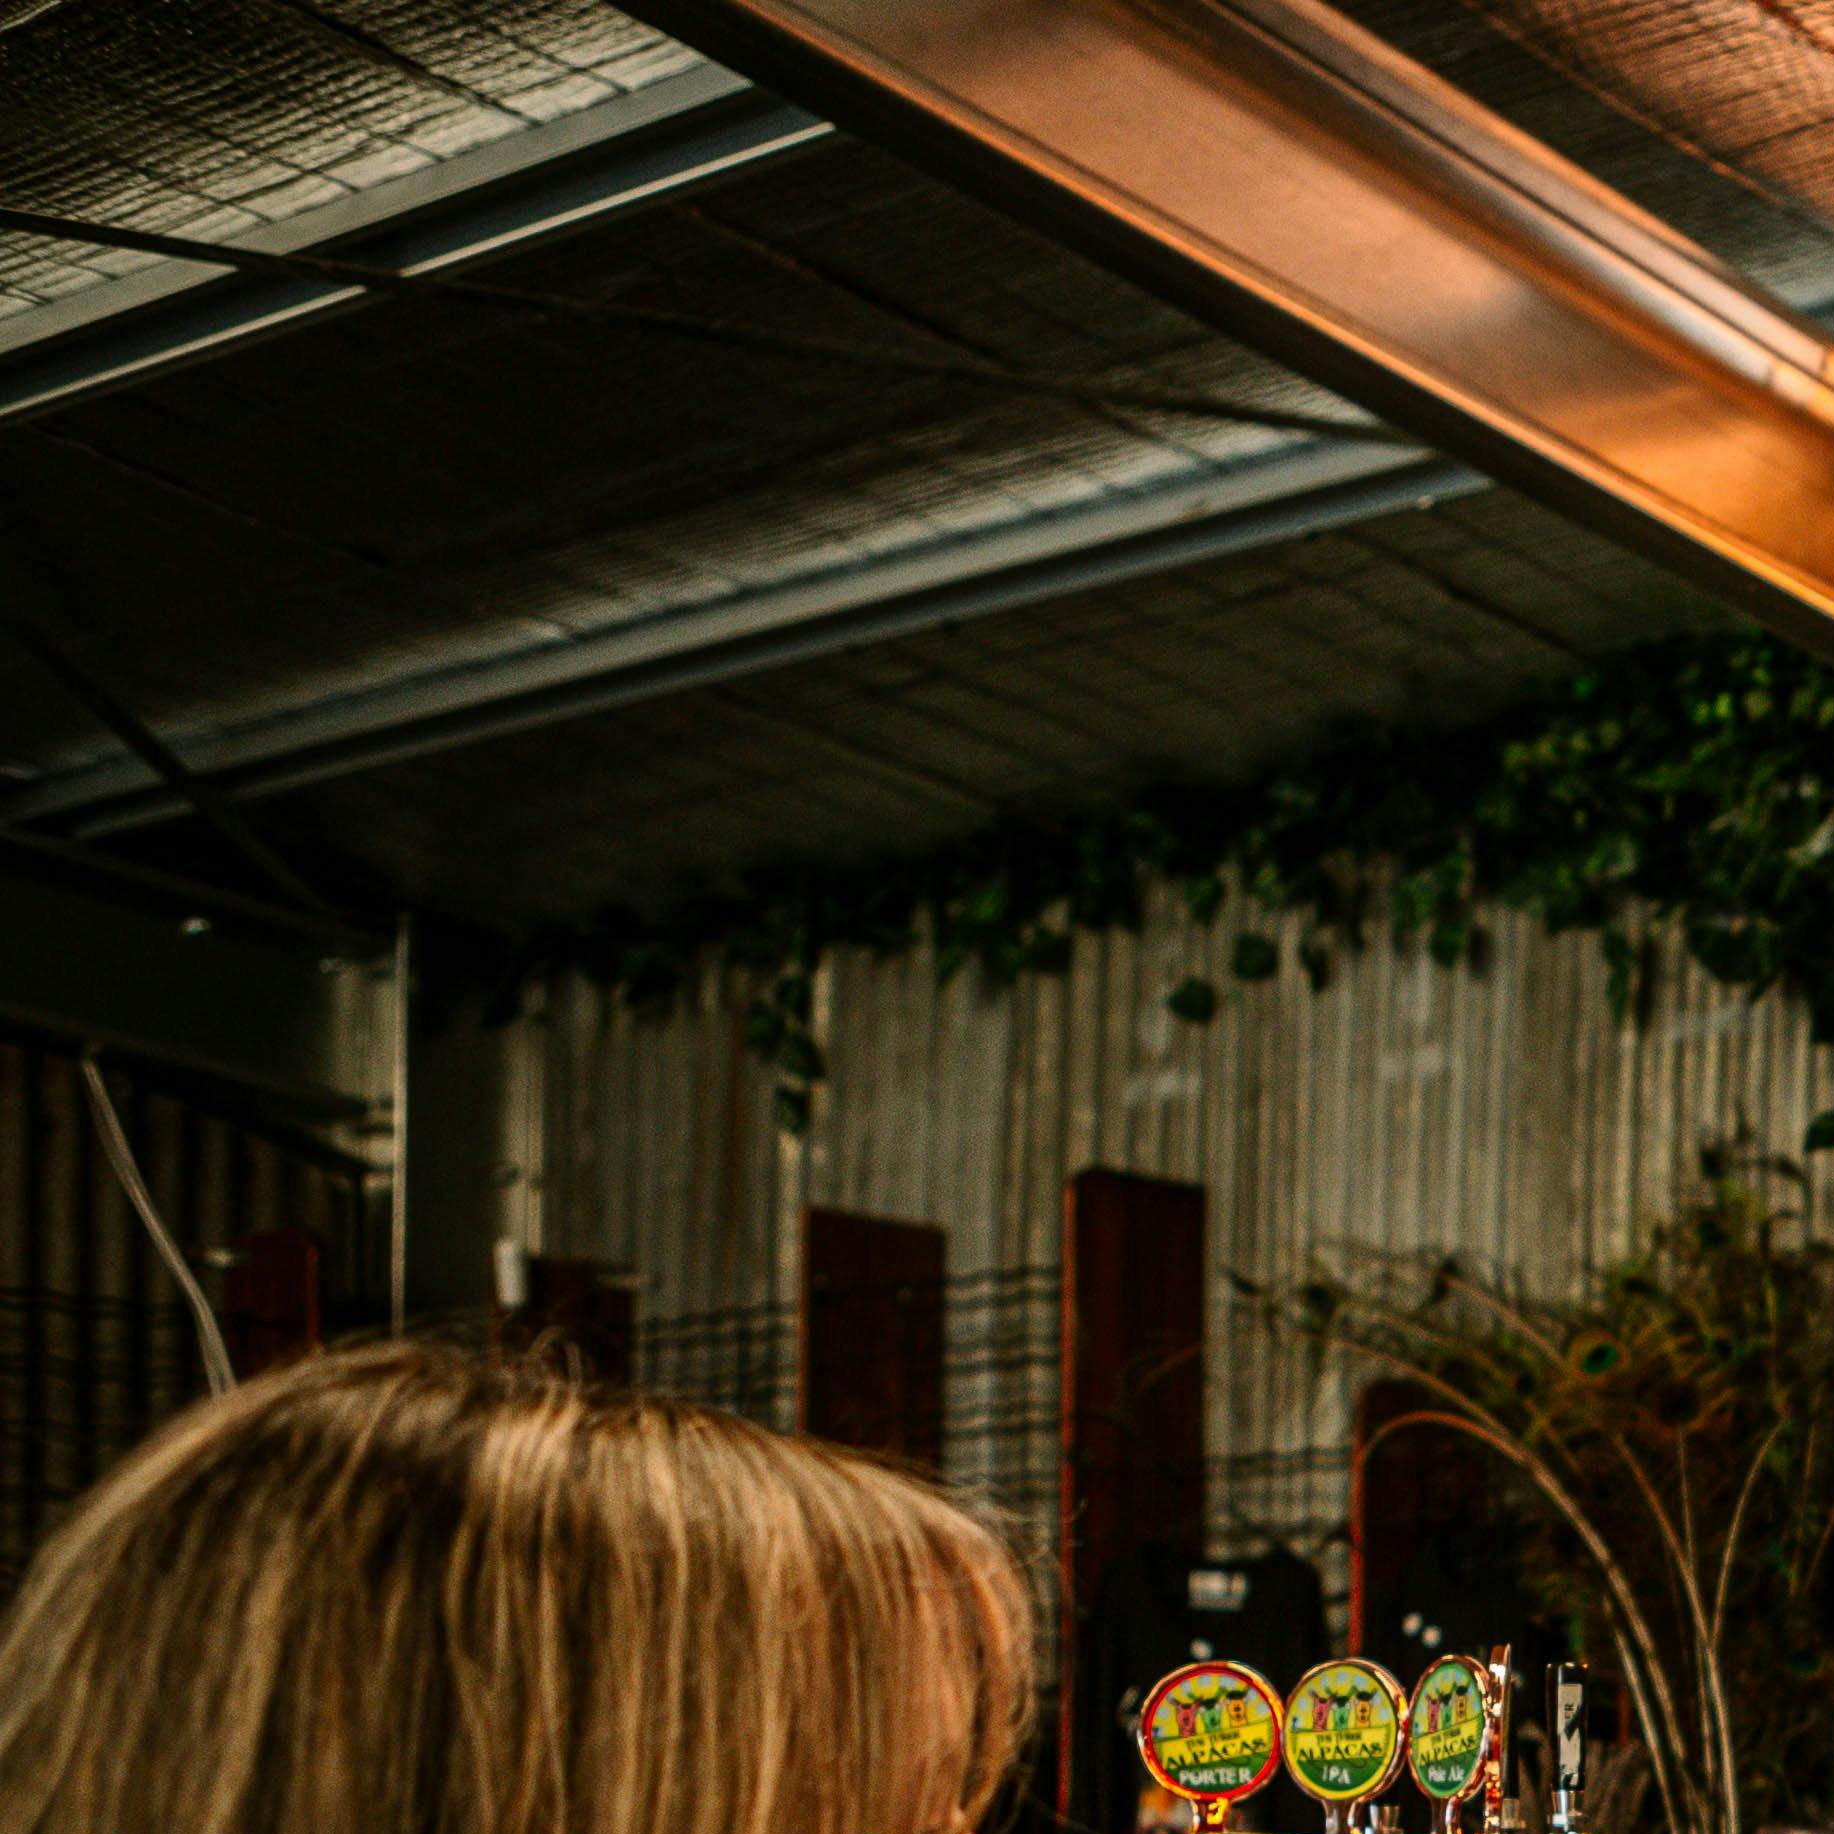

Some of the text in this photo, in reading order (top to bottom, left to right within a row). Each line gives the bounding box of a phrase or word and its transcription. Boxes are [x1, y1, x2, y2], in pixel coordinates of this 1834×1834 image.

[1166, 1737, 1267, 1769] ALPACAS
[1298, 1742, 1383, 1764] ALPACAS
[1179, 1767, 1252, 1786] PORTER
[1322, 1765, 1352, 1785] IPA
